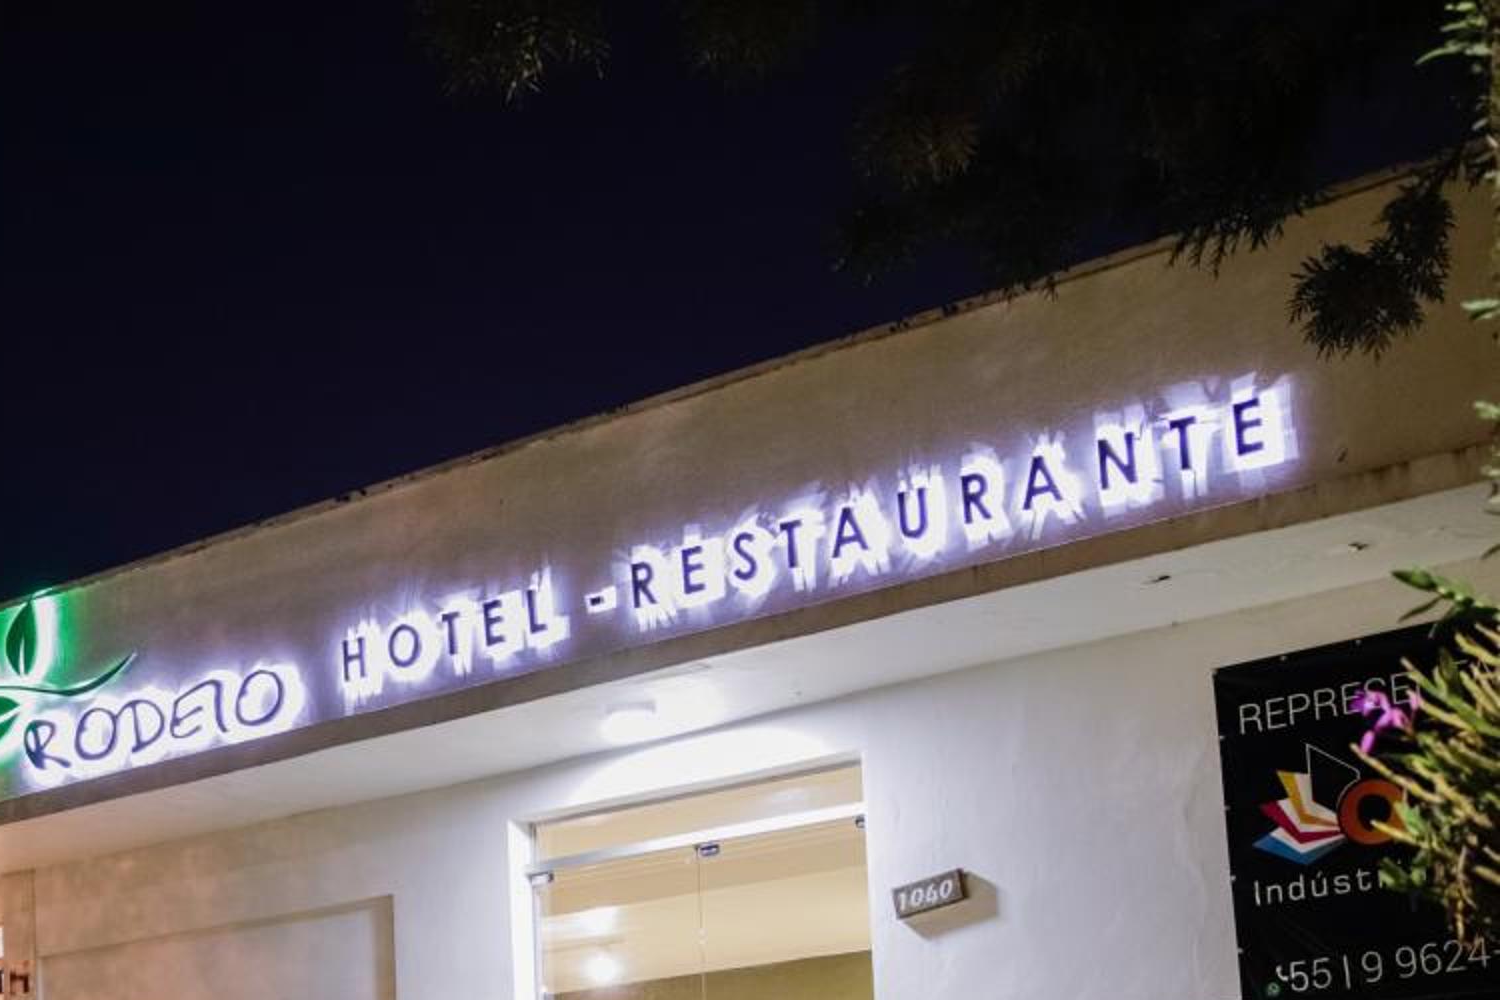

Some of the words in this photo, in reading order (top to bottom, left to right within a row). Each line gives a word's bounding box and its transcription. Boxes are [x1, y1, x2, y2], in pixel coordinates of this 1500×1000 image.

[23, 668, 285, 771] RODEIO
[341, 587, 549, 682] HOTEL
[630, 397, 1264, 608] RESTAURANTE
